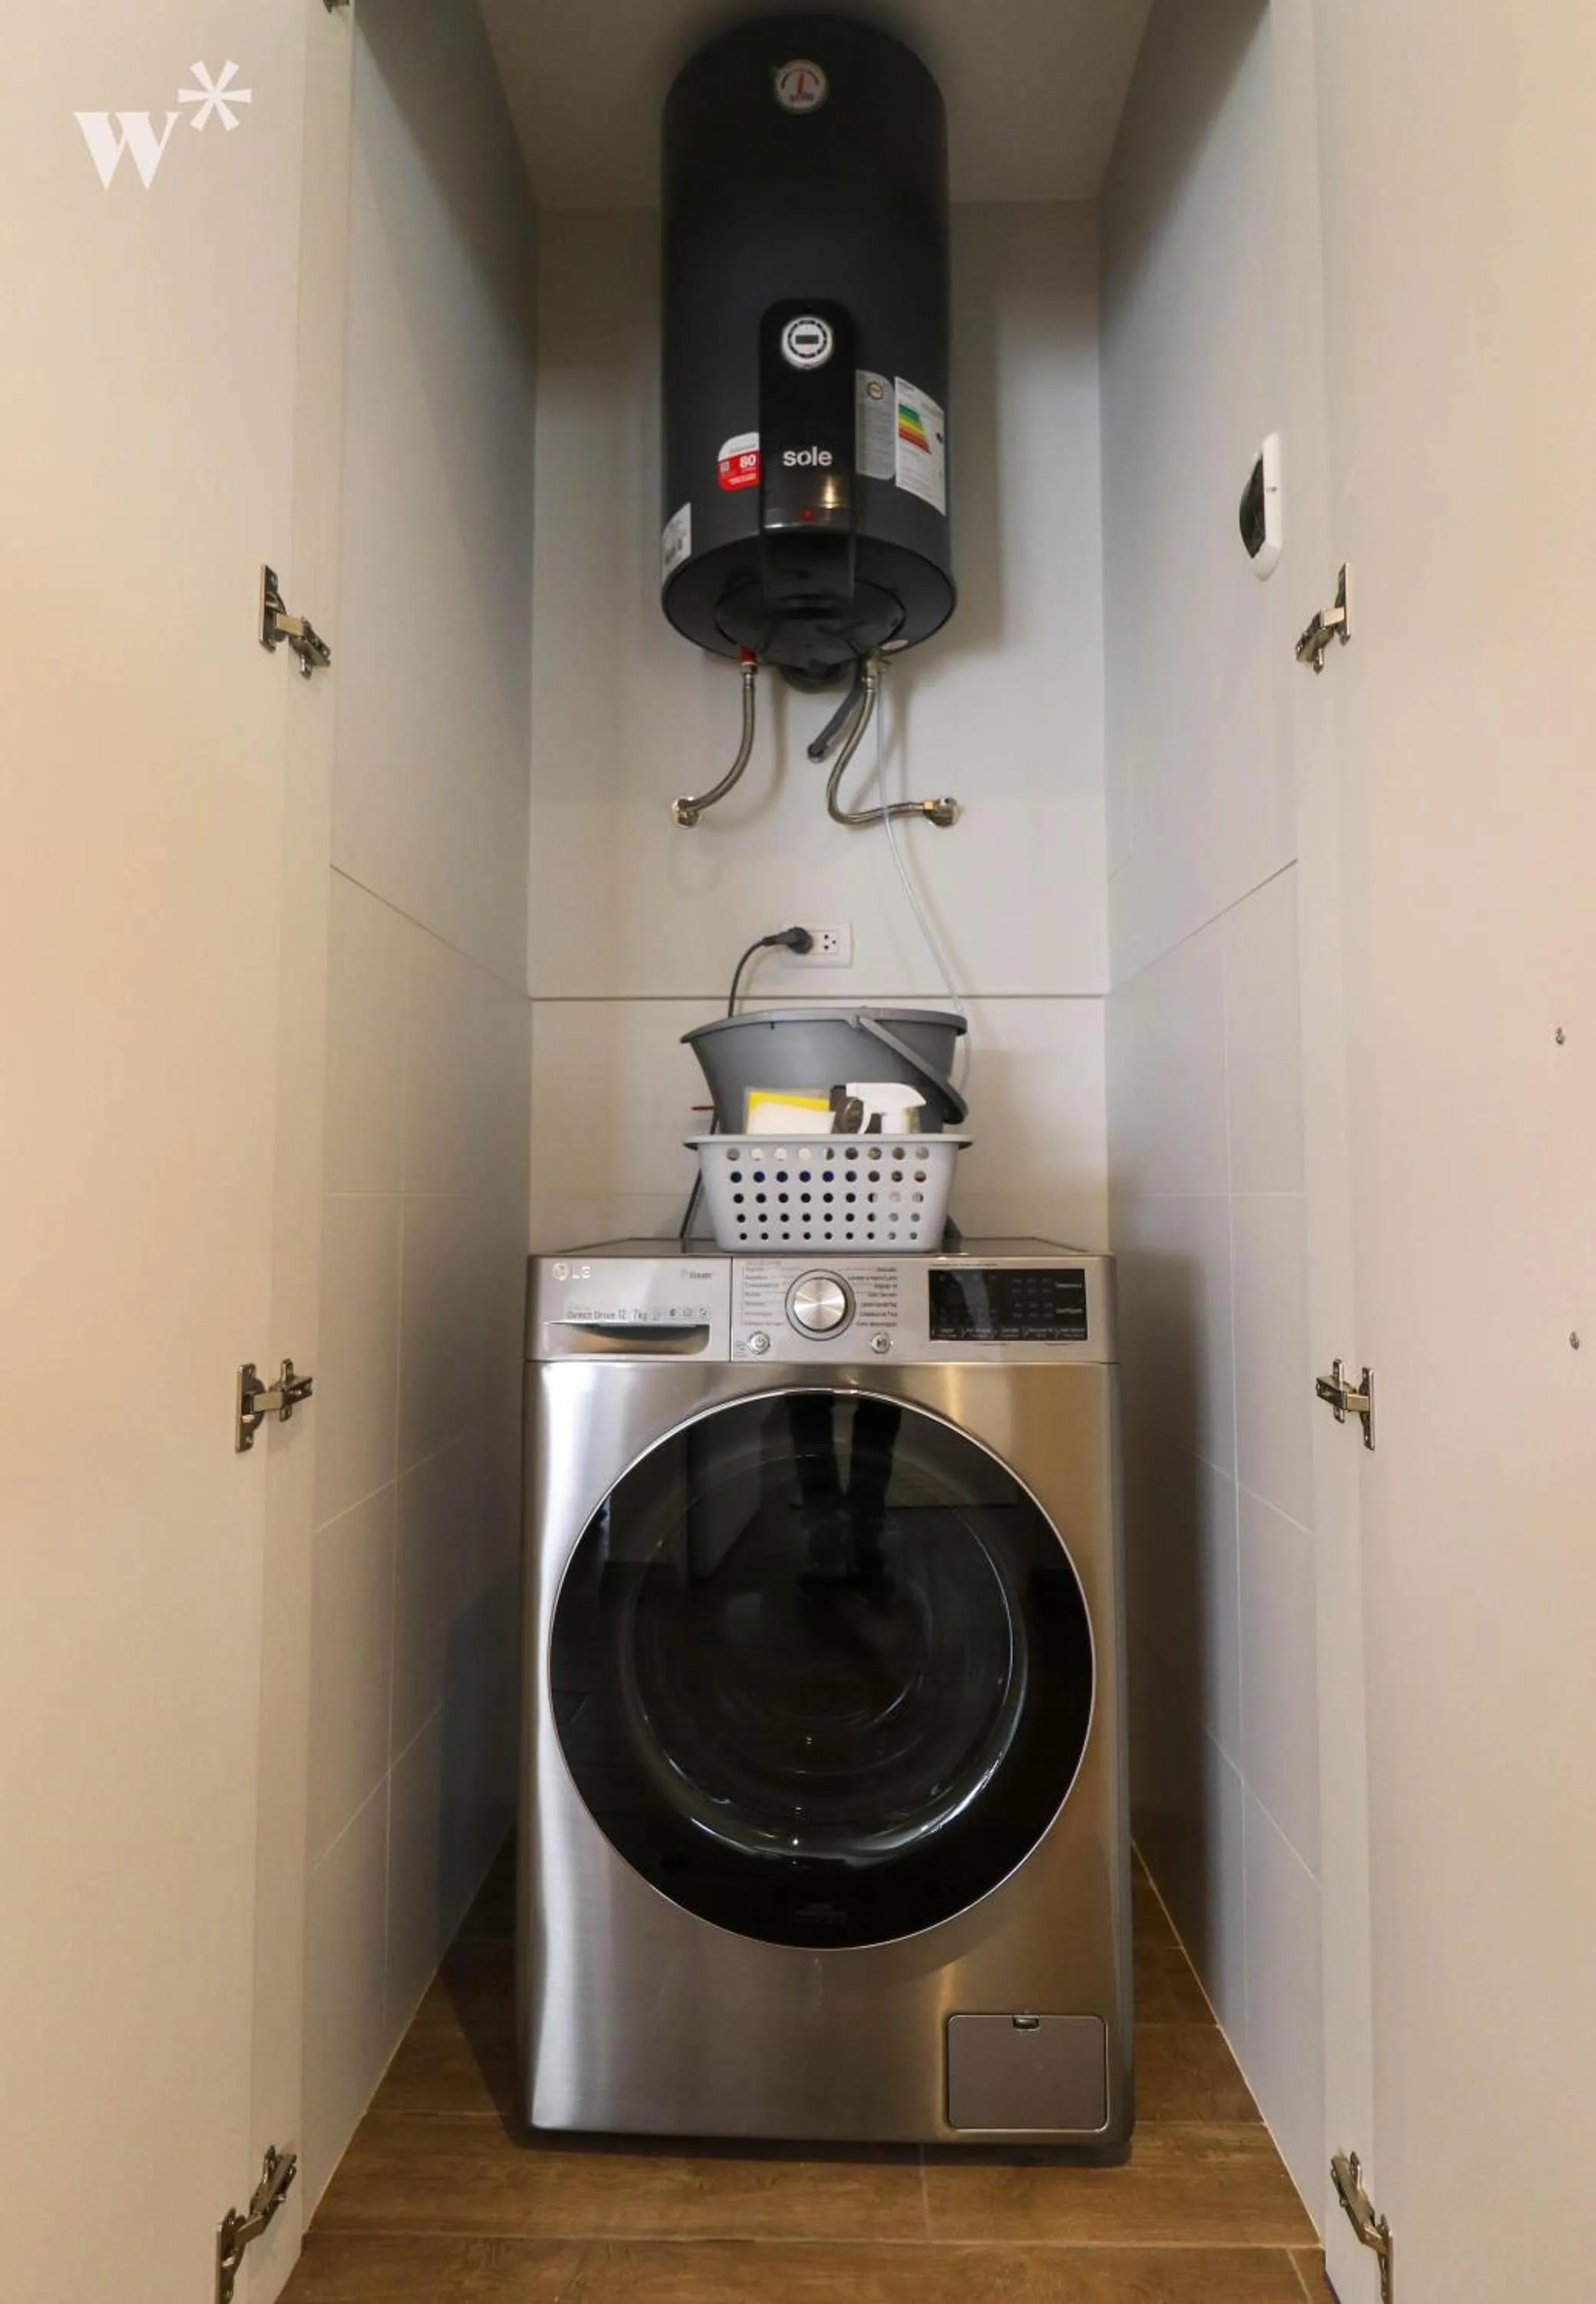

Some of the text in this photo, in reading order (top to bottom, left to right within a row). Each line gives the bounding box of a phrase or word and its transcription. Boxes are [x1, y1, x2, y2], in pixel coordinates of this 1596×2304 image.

[740, 454, 757, 468] 80
[783, 445, 833, 466] sole
[571, 1266, 591, 1279] LG
